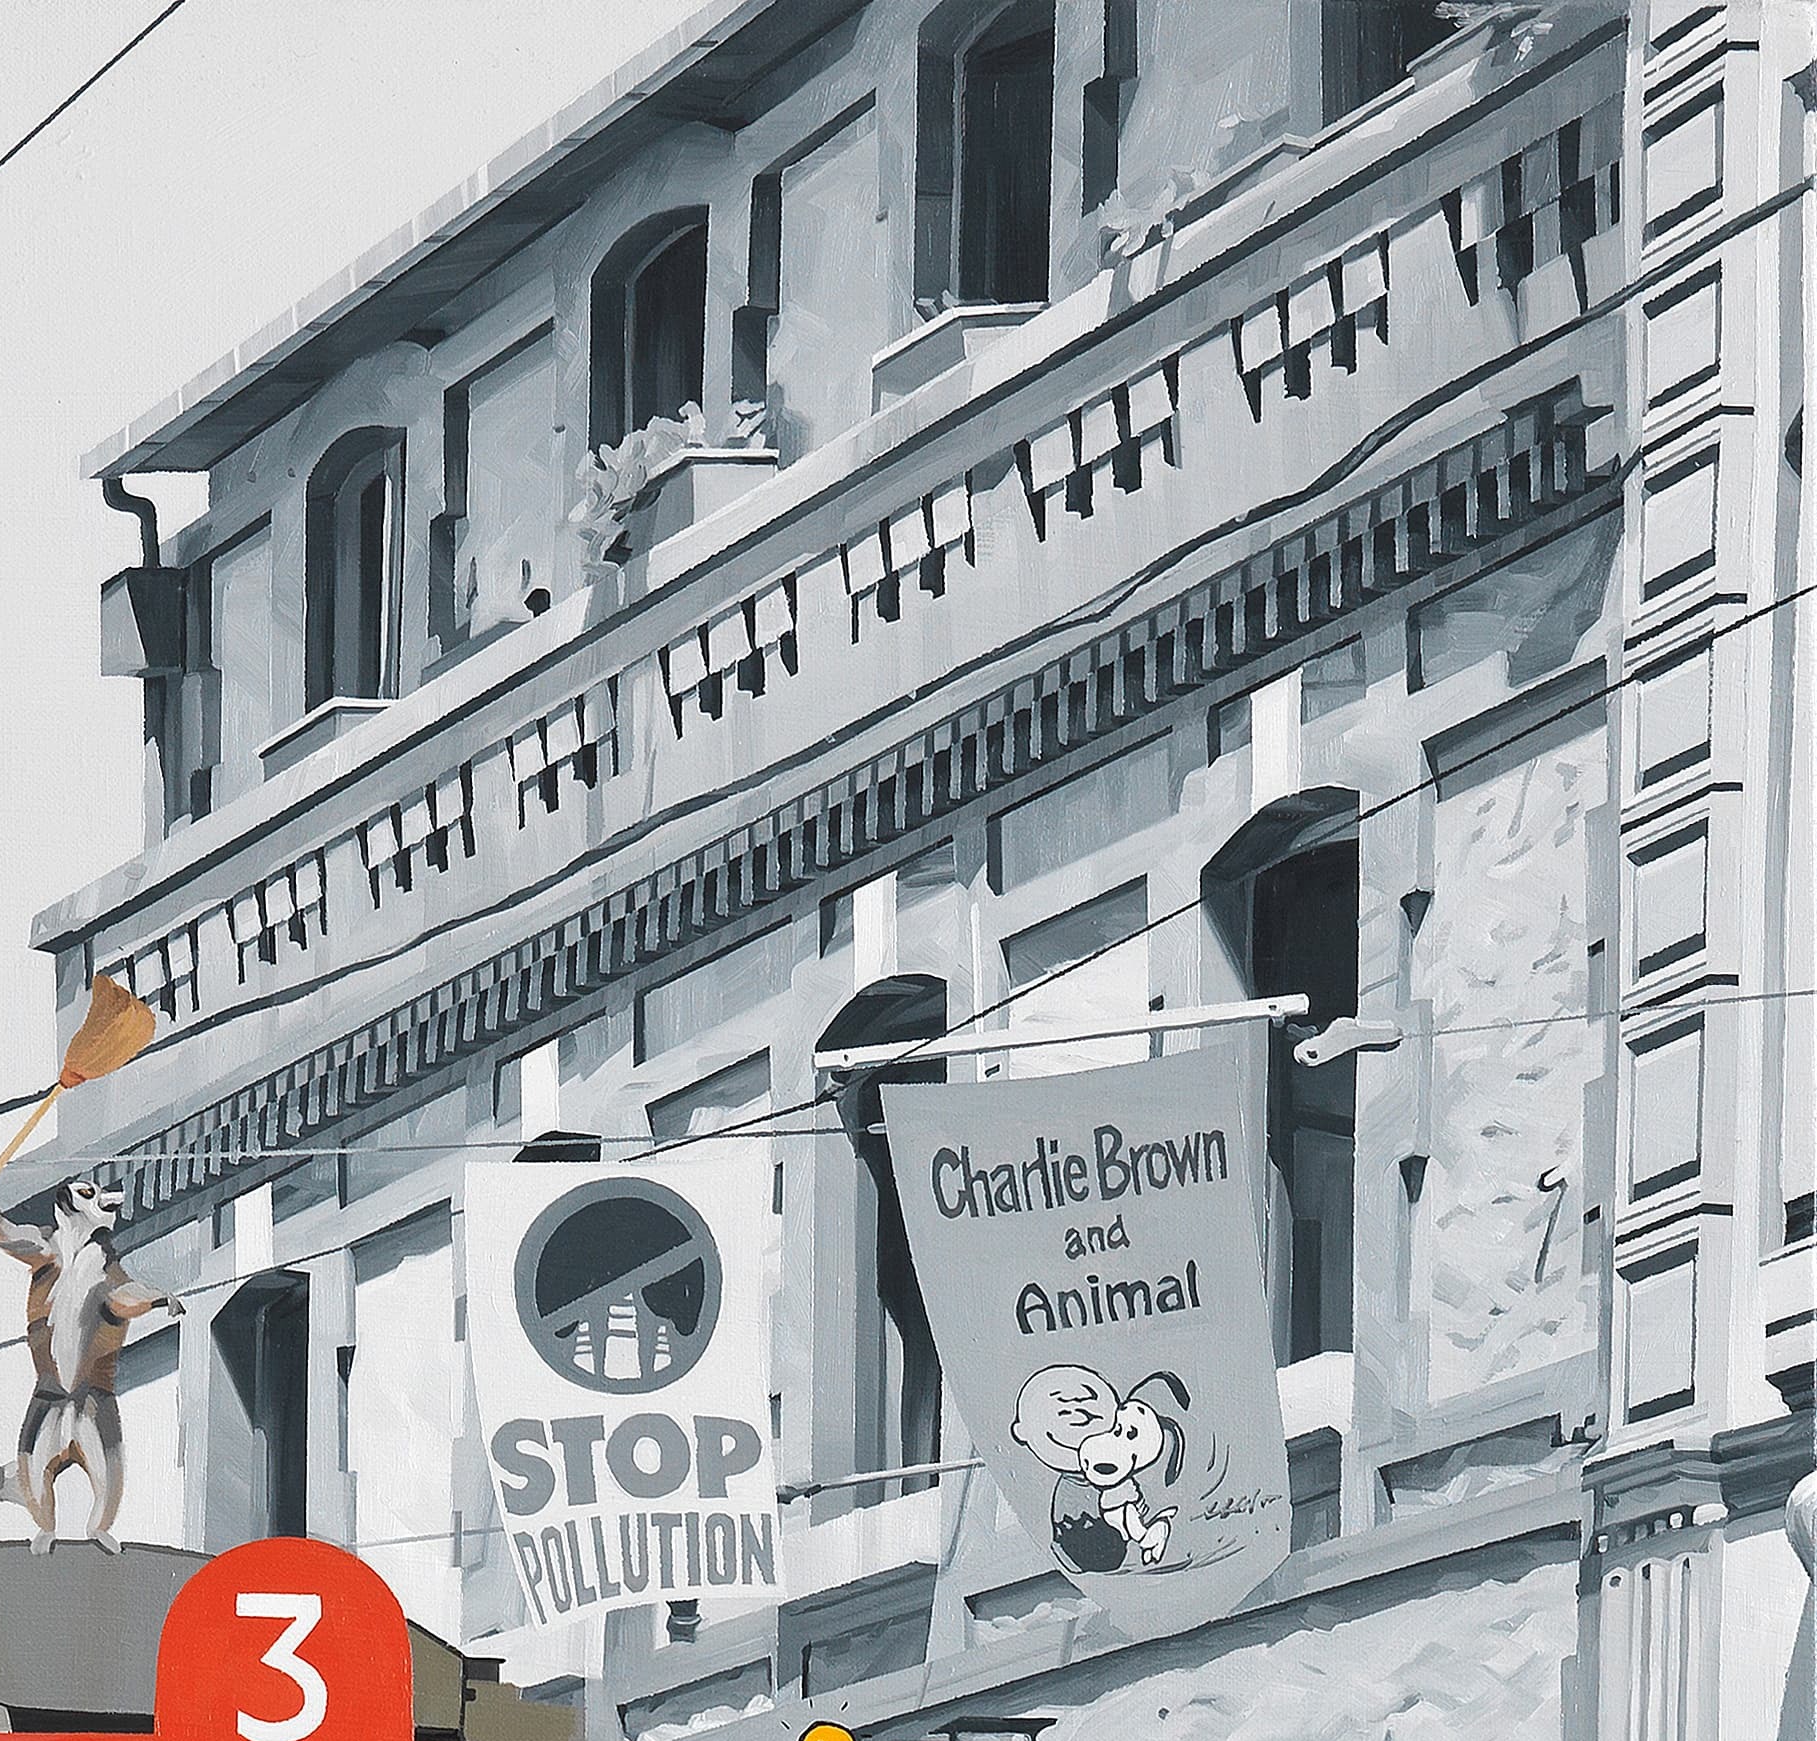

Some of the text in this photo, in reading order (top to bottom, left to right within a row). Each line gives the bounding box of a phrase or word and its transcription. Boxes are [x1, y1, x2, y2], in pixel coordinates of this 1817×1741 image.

[932, 1125, 1229, 1218] Charlie Brown
[1064, 1215, 1130, 1260] and
[1015, 1260, 1201, 1335] Animal
[490, 1412, 762, 1517] STOP
[515, 1511, 777, 1625] POLLUTION
